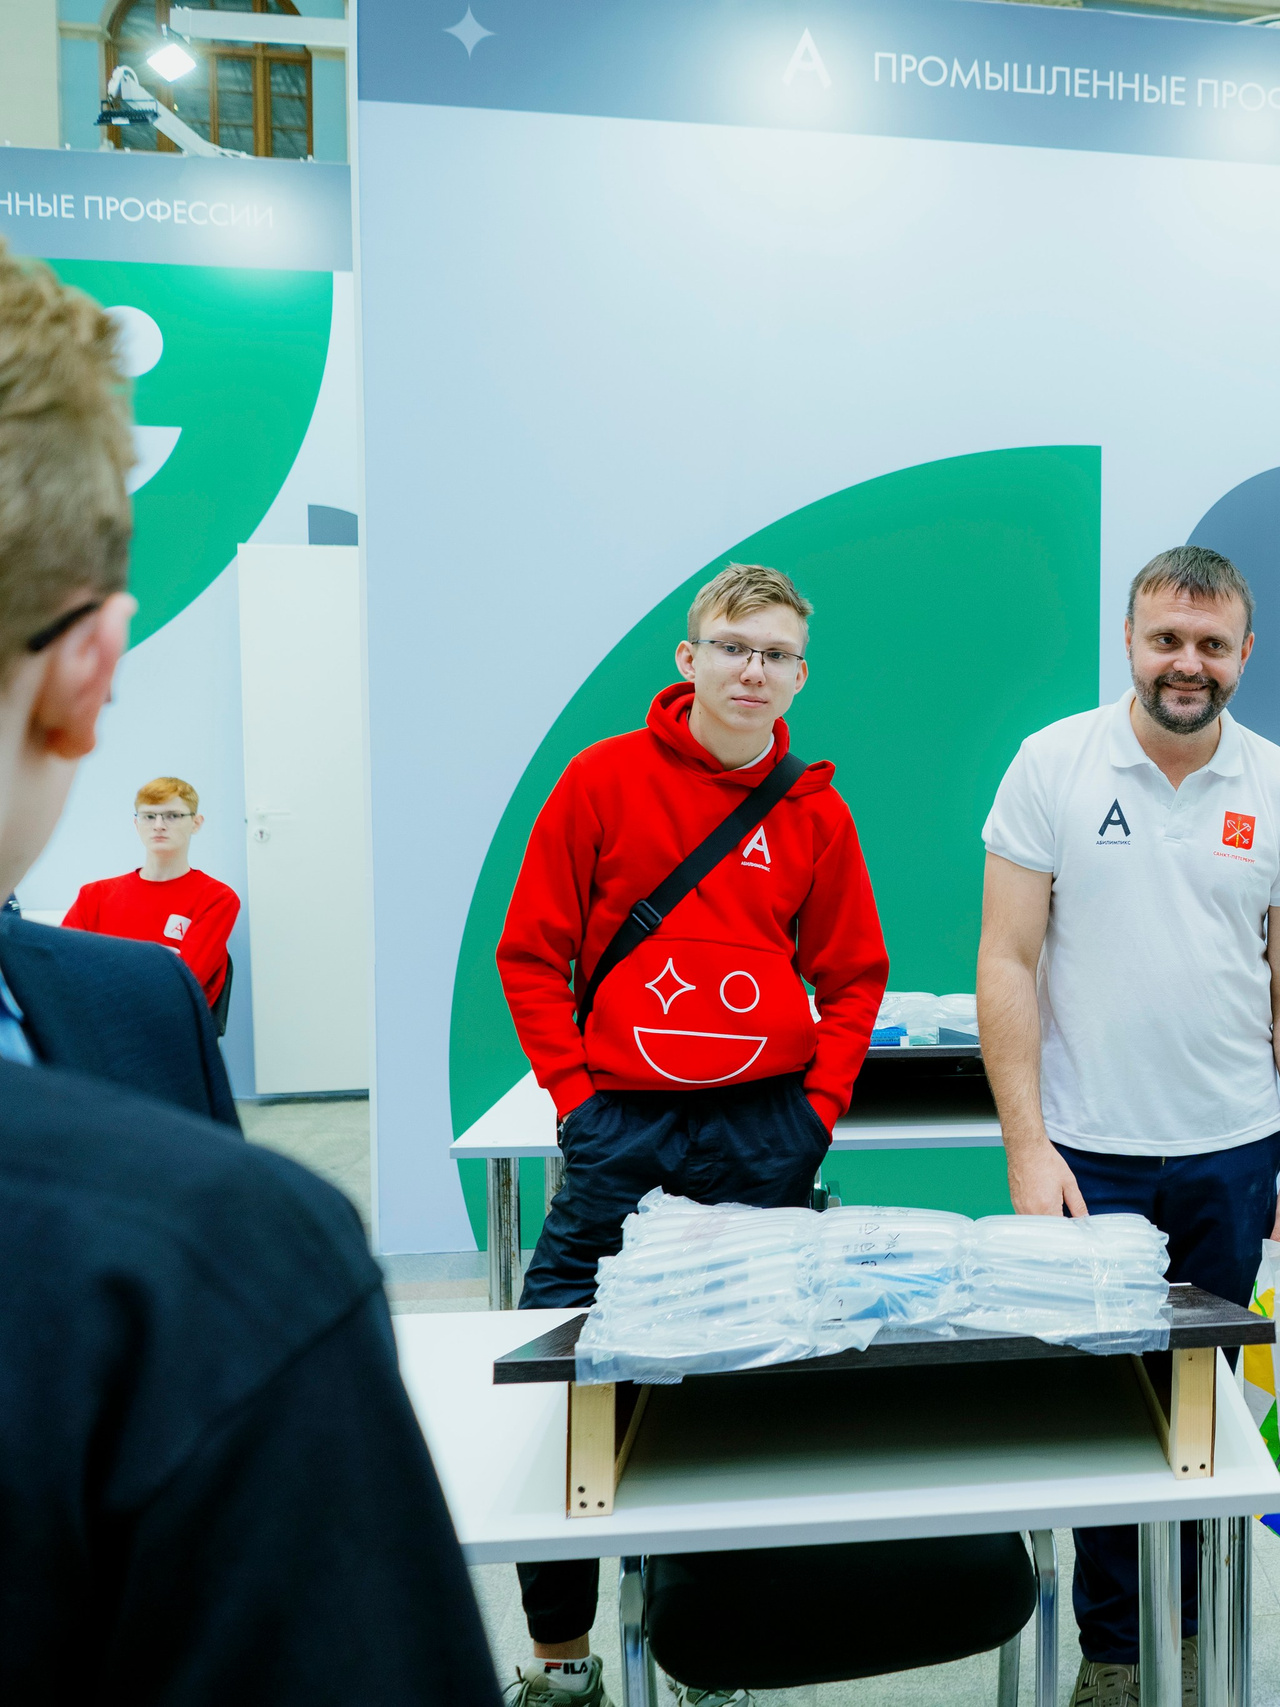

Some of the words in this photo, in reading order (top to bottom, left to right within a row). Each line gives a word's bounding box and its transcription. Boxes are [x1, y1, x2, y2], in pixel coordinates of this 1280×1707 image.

[873, 52, 1187, 106] ПРОМЫШЛЕННЫЕ
[84, 195, 274, 229] ПРОФЕССИИ
[544, 1661, 589, 1675] FILA
